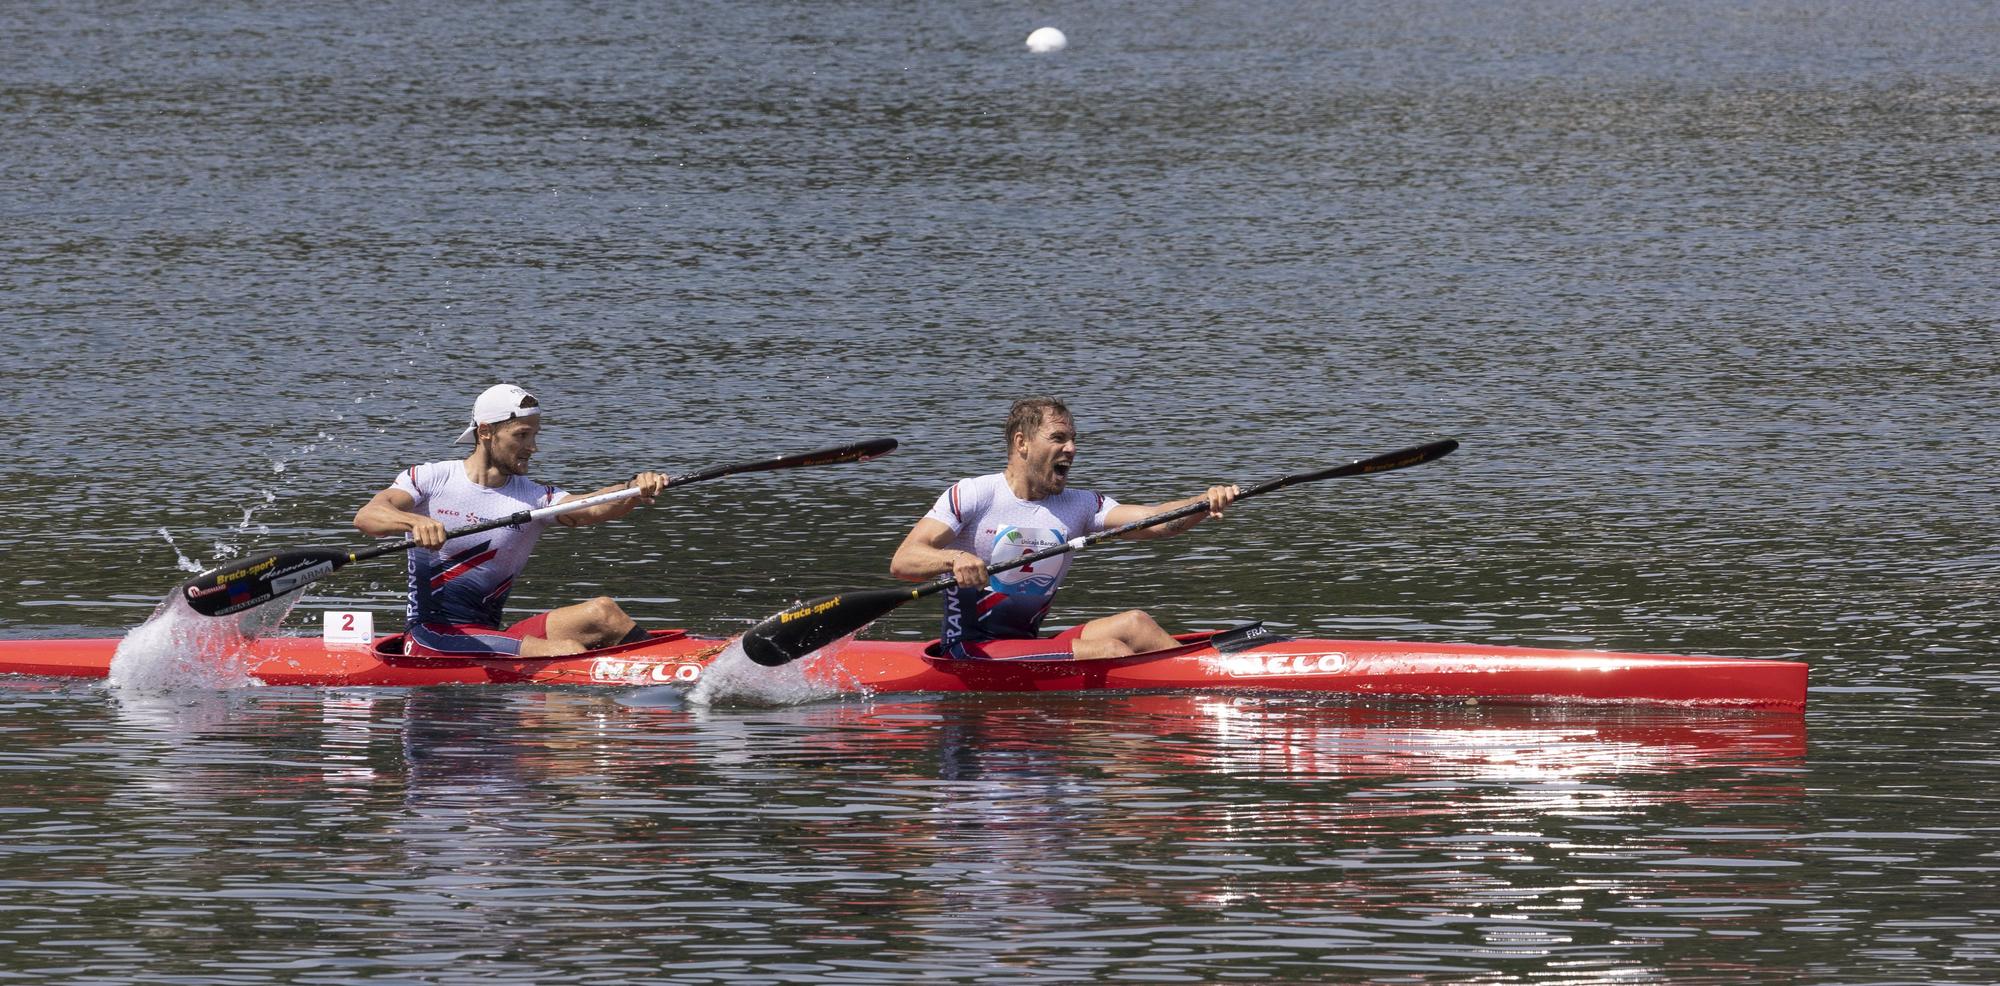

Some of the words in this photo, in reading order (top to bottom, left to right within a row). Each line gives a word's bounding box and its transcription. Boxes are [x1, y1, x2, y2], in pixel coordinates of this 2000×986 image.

[437, 509, 460, 517] NELO
[301, 565, 332, 580] ARMA
[341, 613, 355, 632] 2
[1246, 626, 1267, 639] FRA
